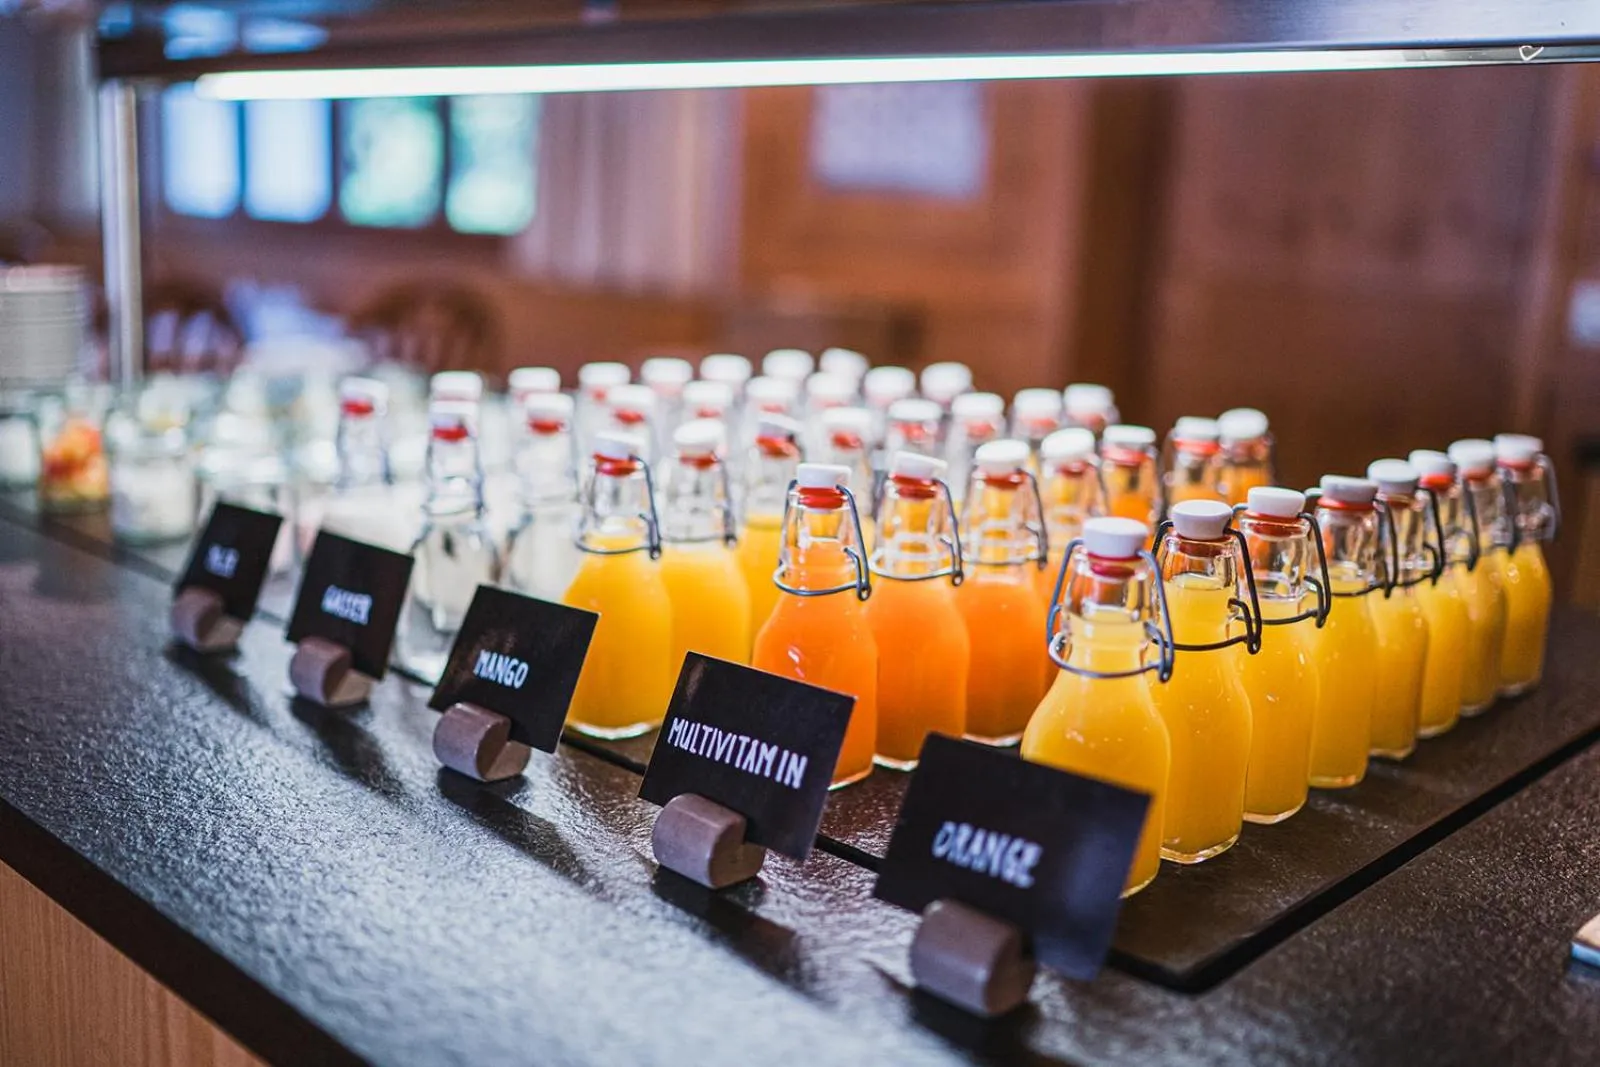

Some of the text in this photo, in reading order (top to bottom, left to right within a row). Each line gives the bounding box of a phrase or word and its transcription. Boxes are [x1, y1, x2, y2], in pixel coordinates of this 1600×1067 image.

[473, 650, 528, 688] MANGO
[667, 717, 808, 790] MULTIVITAMIN
[933, 821, 1042, 888] ORANGE
